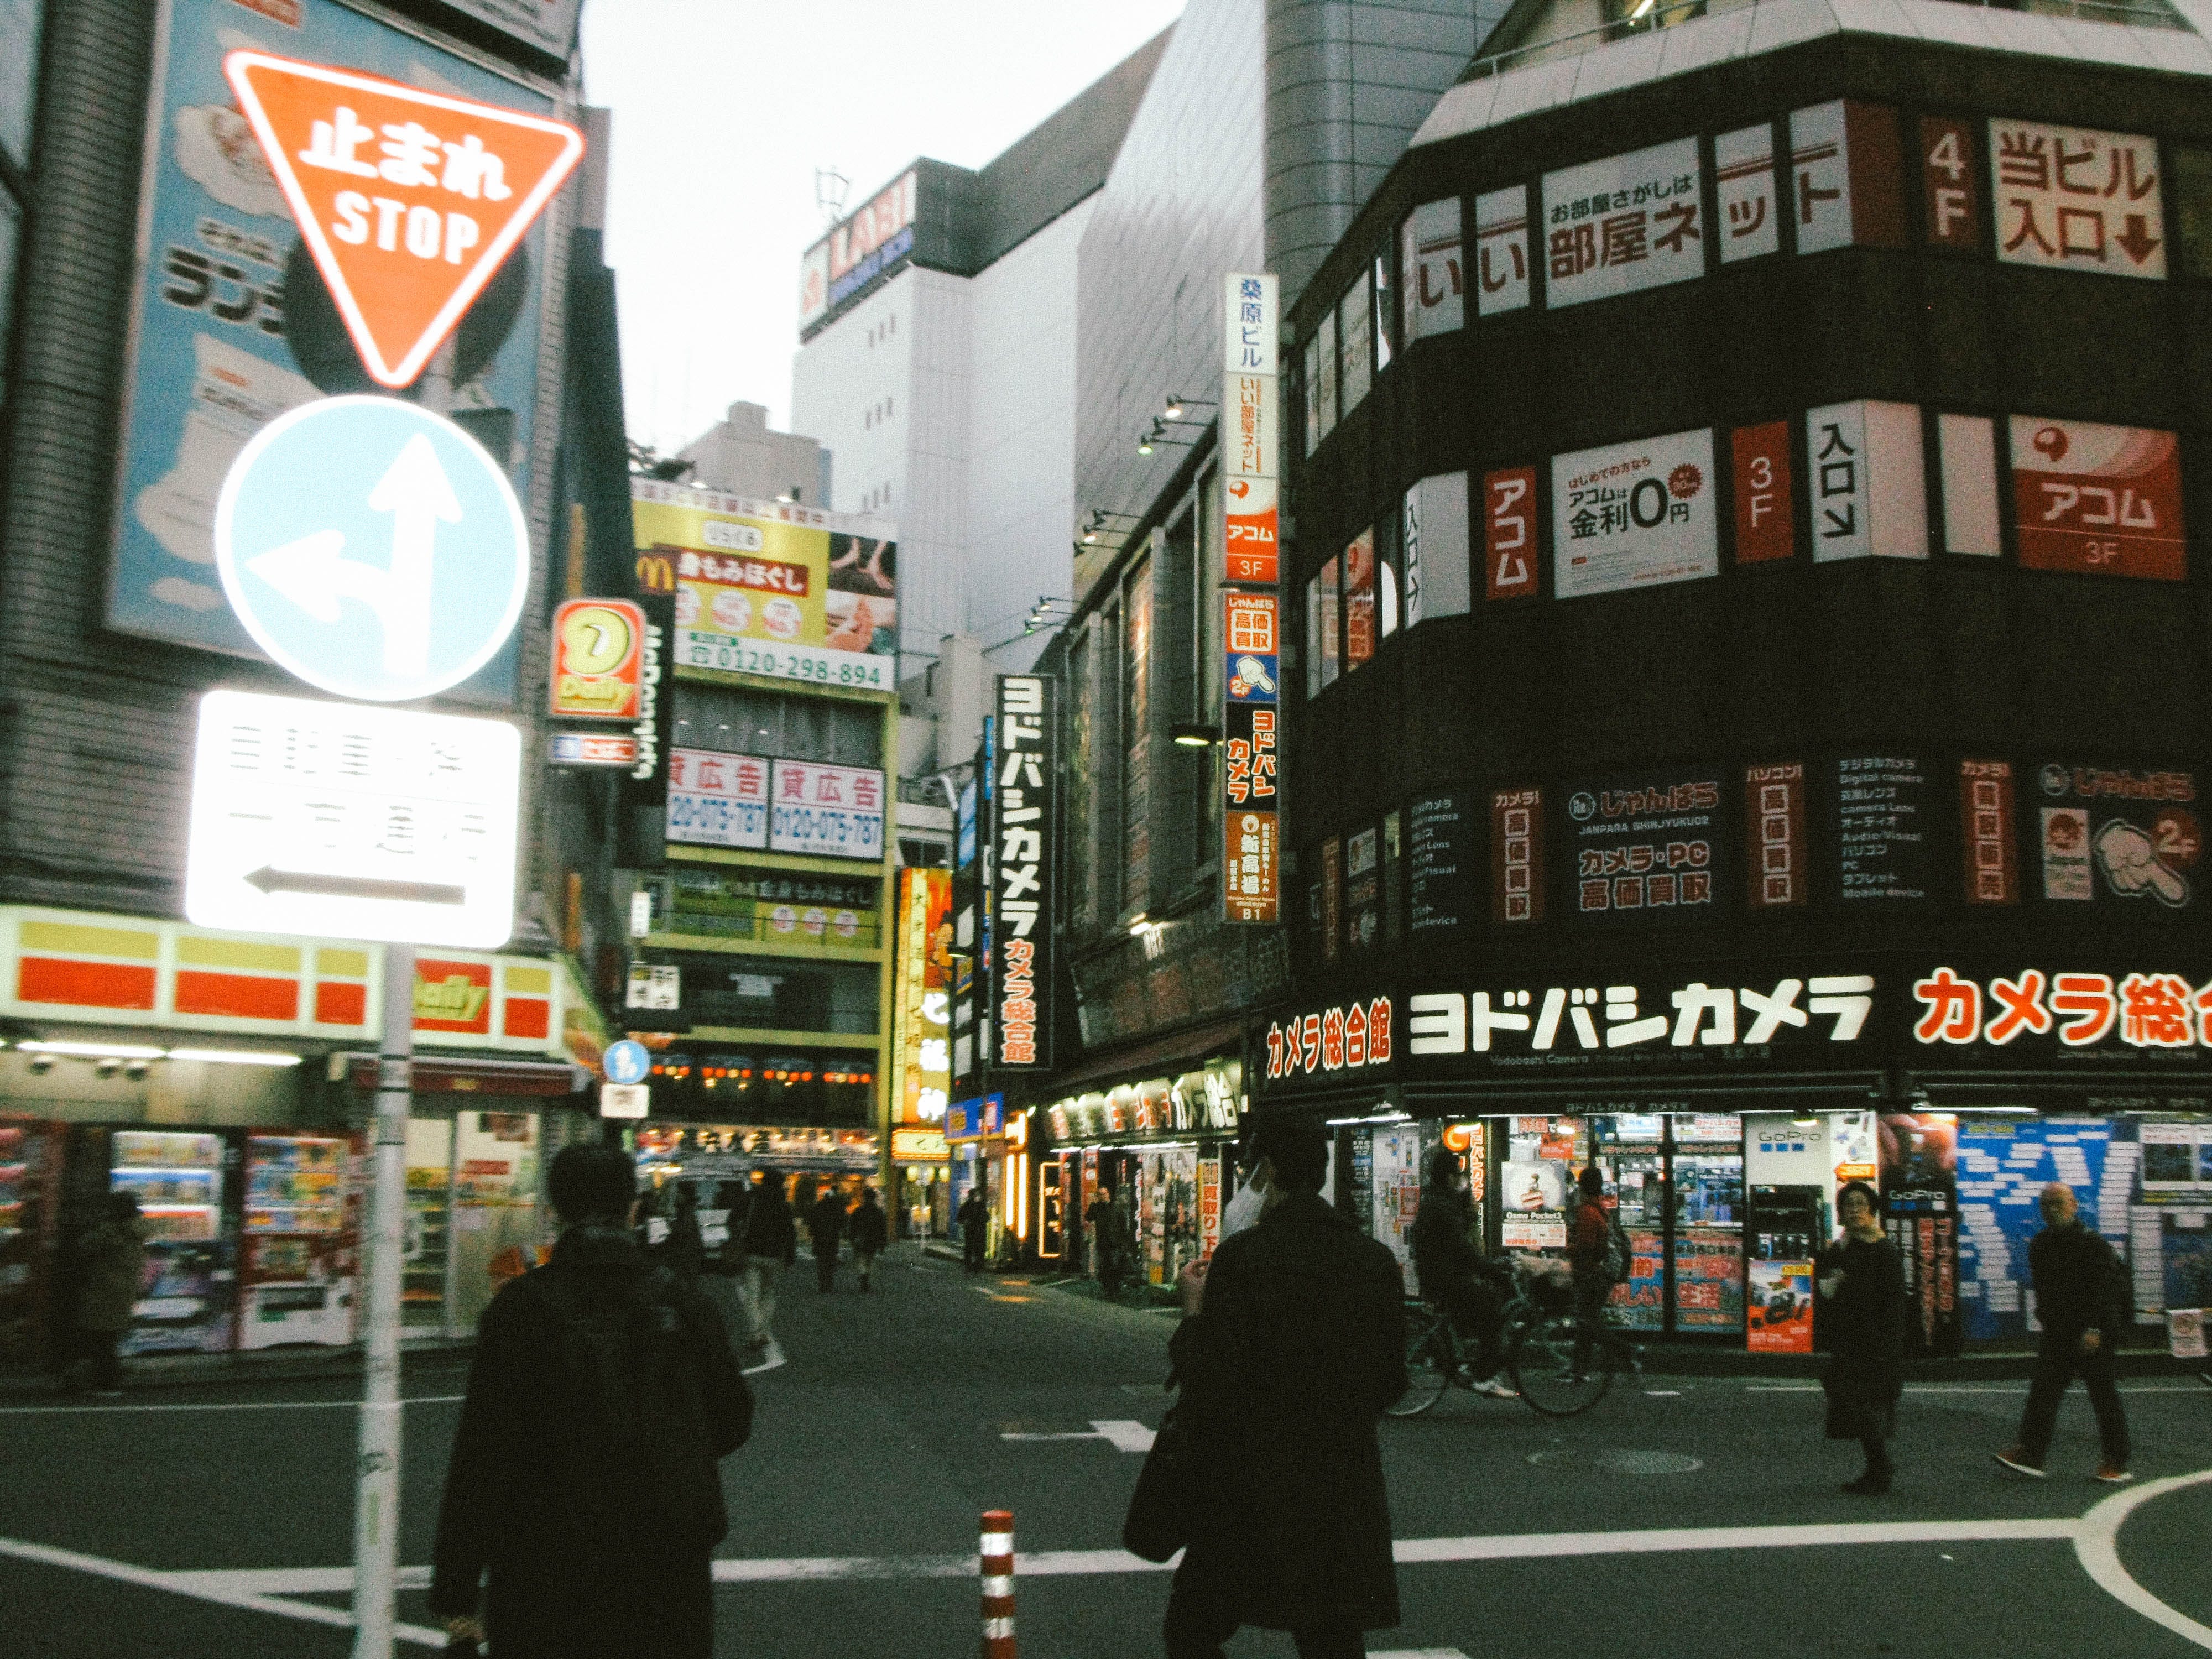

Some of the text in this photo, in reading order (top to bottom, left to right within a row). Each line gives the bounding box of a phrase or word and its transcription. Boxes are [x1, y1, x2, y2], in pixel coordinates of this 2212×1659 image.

[299, 107, 513, 201] 止まれ
[2000, 132, 2154, 200] 当ビル
[1552, 174, 1693, 221] お部屋さがしは
[1929, 132, 1968, 236] 4F
[332, 190, 479, 264] STOP
[1418, 171, 1841, 309] いい部屋ネット
[2005, 198, 2106, 262] 入口
[1241, 279, 1261, 367] 桑原ビル
[1241, 377, 1254, 473] いい部屋ネット
[1569, 456, 1651, 489] はじめての方なら
[1819, 424, 1855, 499] 入口
[1569, 488, 1627, 508] アコムは
[1750, 457, 1773, 528] 3F
[2041, 483, 2158, 529] アコム
[1228, 525, 1274, 542] アコム
[1494, 479, 1528, 587] アコム
[2086, 542, 2118, 563] 3F
[1240, 560, 1262, 576] 3F
[717, 647, 880, 685] 0120-298-894
[1230, 680, 1248, 696] 2F
[1227, 738, 1250, 804] カメラ
[1251, 709, 1276, 797] ヨドバシ
[1839, 757, 1916, 771] デジタルカメラ
[781, 768, 878, 806] 貸広告
[1601, 782, 1719, 818] じゃんぱら
[1840, 773, 1879, 785] Digital
[1001, 678, 1043, 936] ヨドバシカメラ
[1579, 822, 1629, 836] JANPARA
[1842, 860, 1859, 870] PC
[1579, 870, 1712, 911] 高価買取
[413, 970, 489, 1021] aily
[1001, 938, 1036, 1064] カメラ総合館
[1410, 975, 1875, 1054] ヨドバシカメラ
[1913, 966, 2212, 1048] カメラ総
[1267, 995, 1392, 1079] カメラ総合館
[1491, 1054, 1544, 1066] Yodobashi
[1547, 1054, 1588, 1065] Camera
[1759, 1130, 1822, 1142] GoPro
[1890, 1190, 1946, 1201] GoPro
